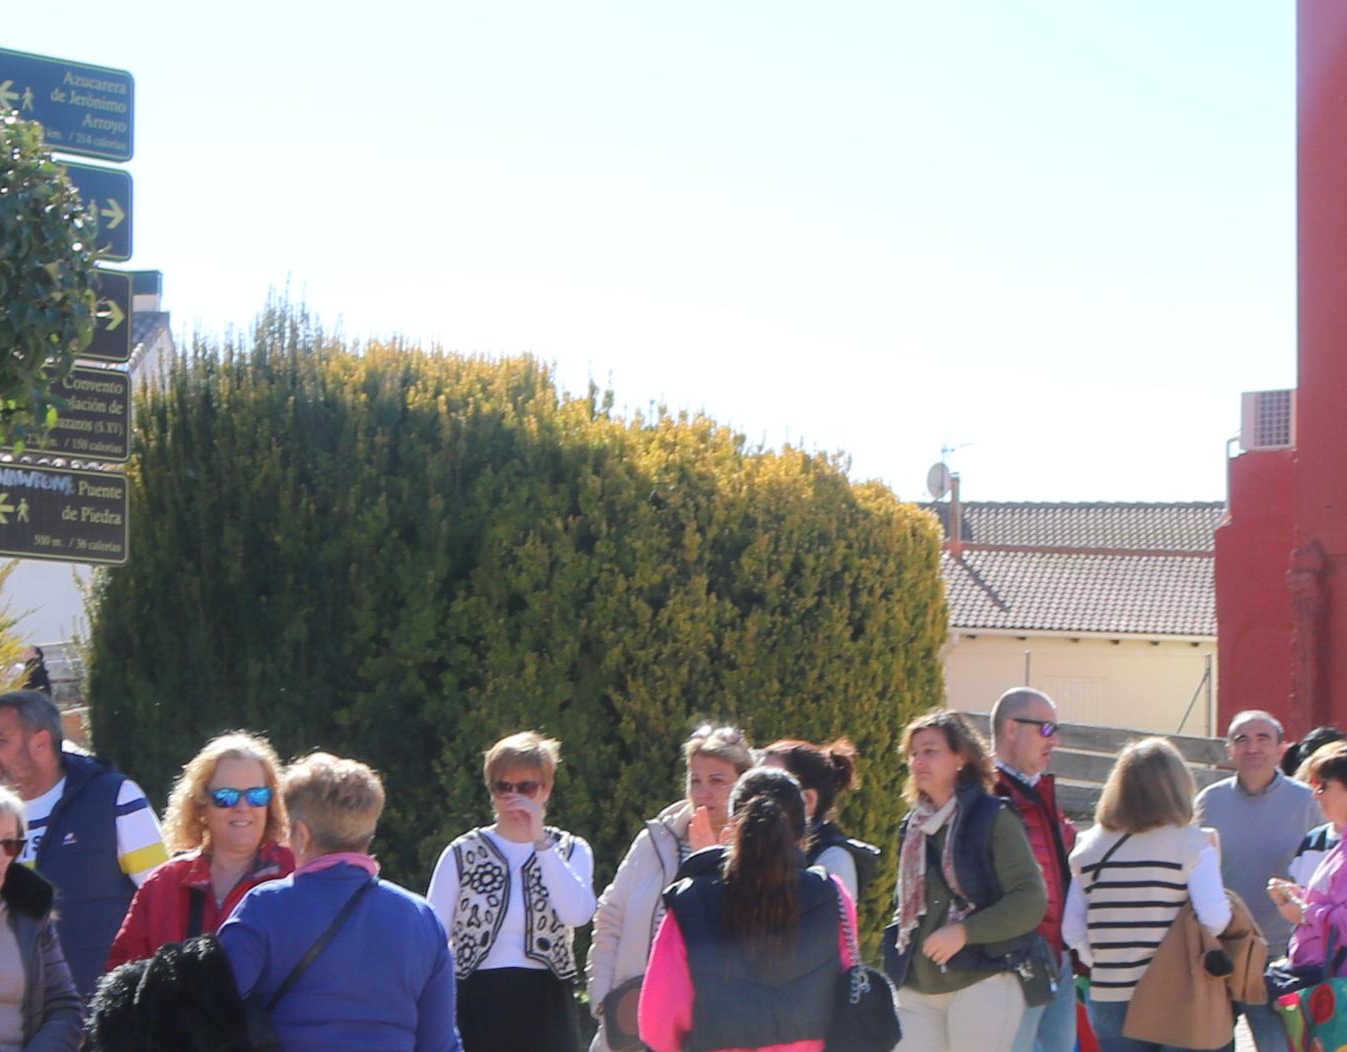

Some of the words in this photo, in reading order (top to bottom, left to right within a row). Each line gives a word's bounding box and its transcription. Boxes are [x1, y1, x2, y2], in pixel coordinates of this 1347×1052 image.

[63, 72, 126, 95] Azucarera
[50, 87, 66, 103] de
[82, 113, 126, 134] Arroyo
[62, 375, 123, 394] Convento
[108, 399, 124, 415] de
[78, 480, 123, 499] Puente
[62, 504, 78, 521] de
[81, 506, 123, 525] Piedra
